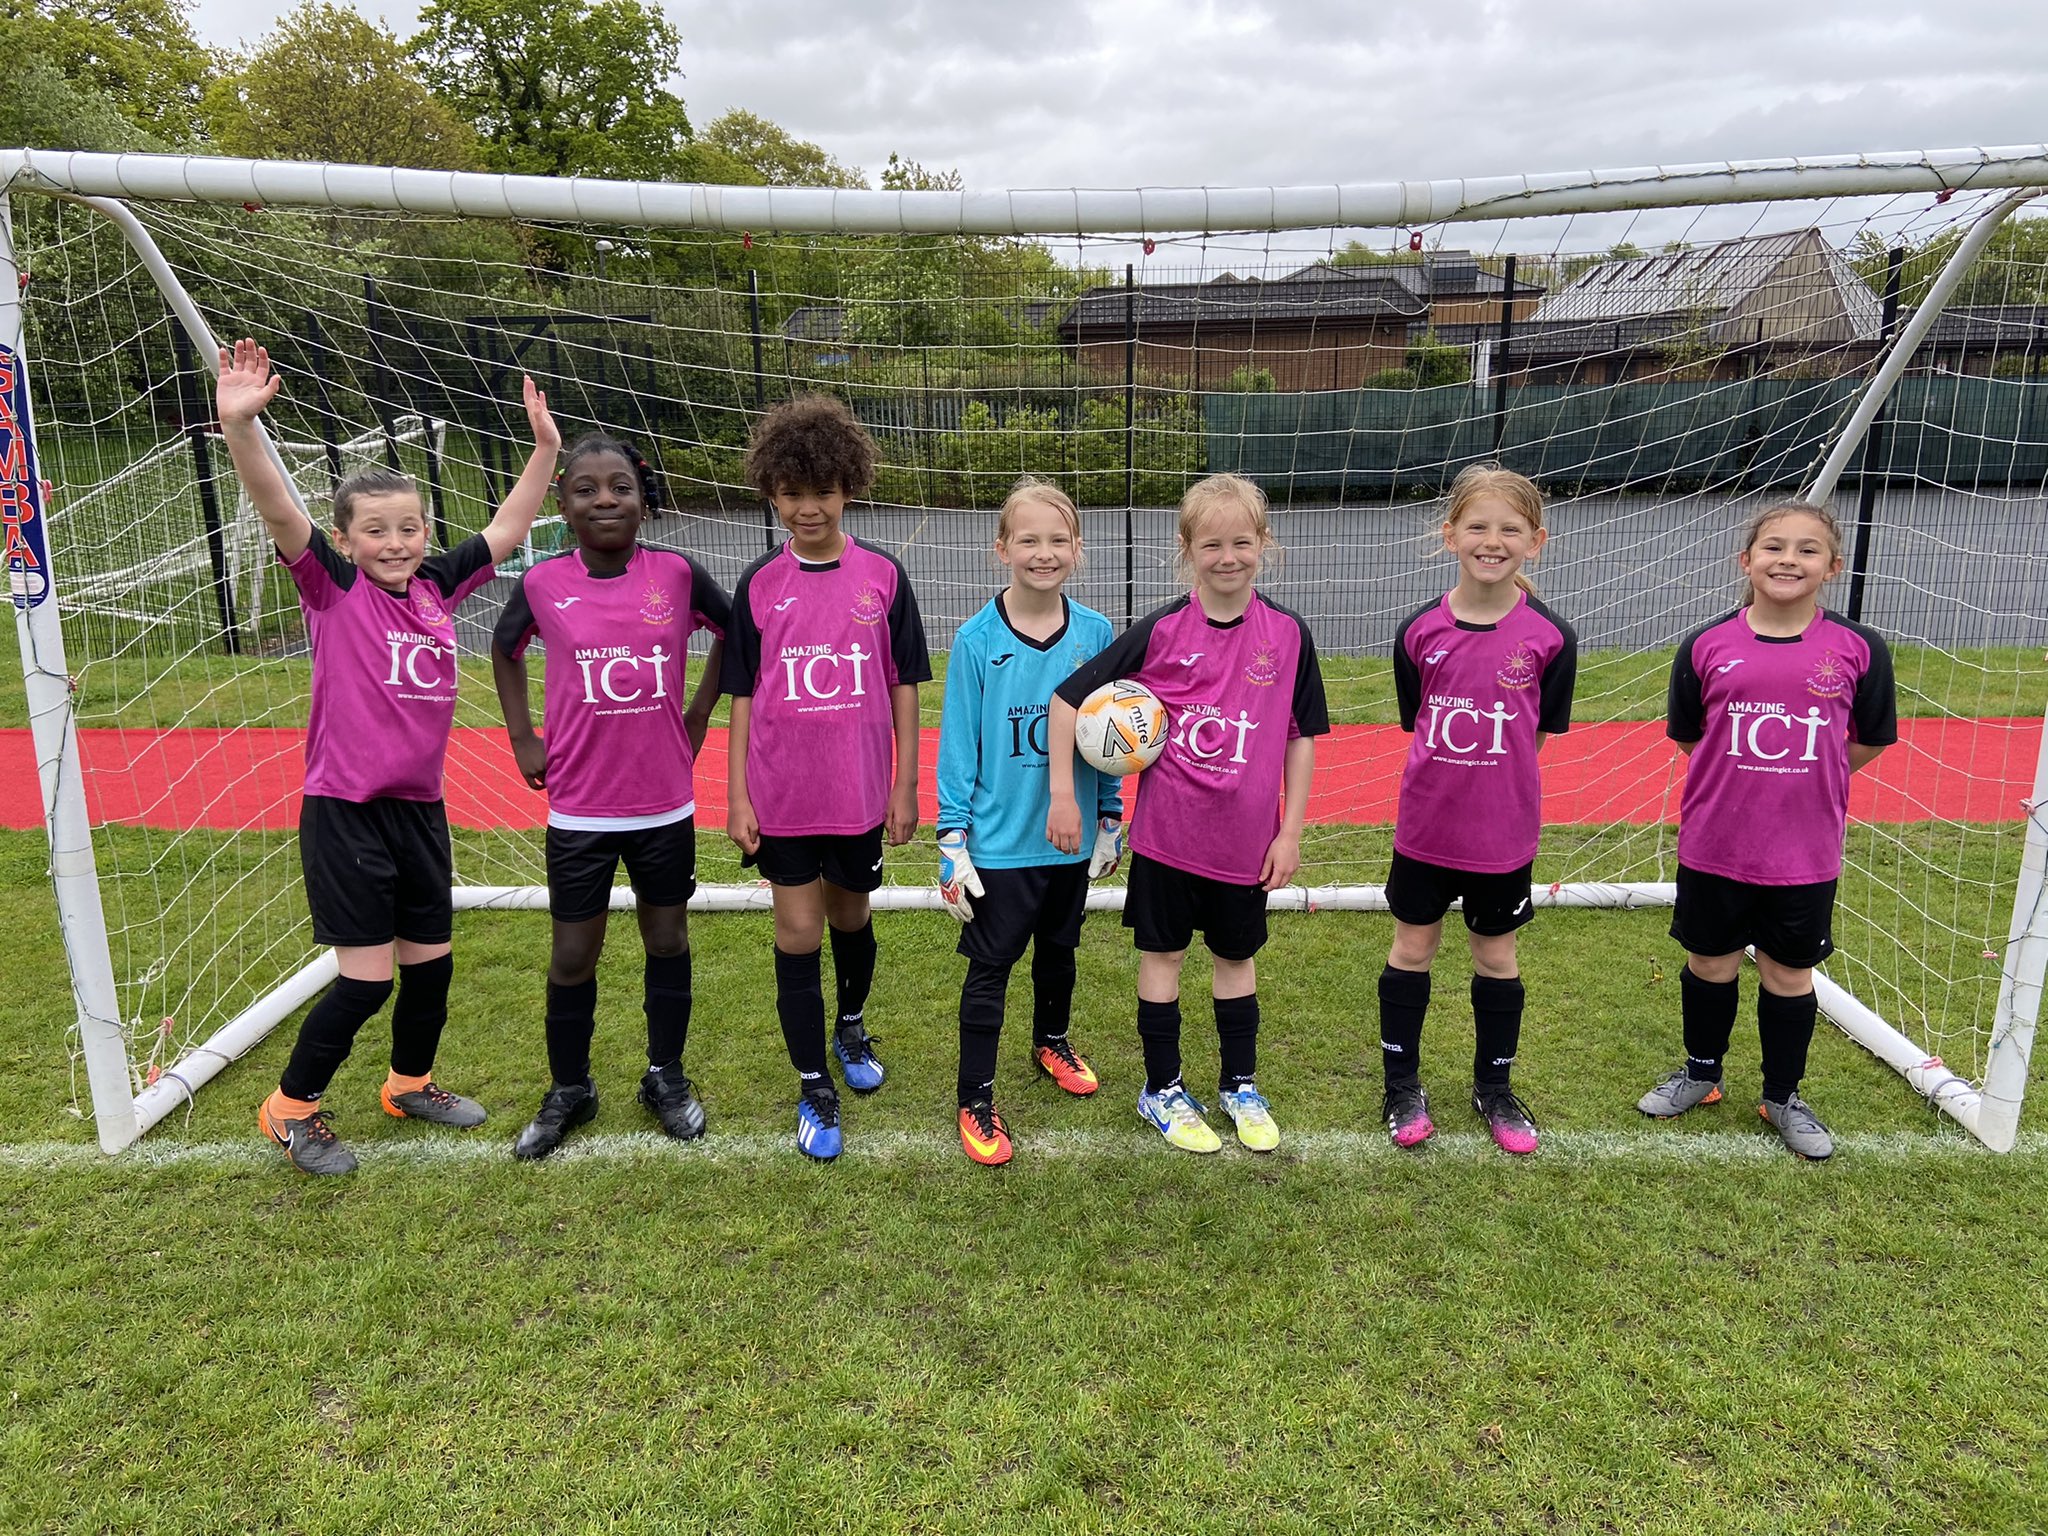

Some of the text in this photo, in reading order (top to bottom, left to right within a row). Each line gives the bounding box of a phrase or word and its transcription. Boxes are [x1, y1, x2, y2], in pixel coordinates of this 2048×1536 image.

[640, 608, 662, 621] Grange
[849, 608, 871, 621] Grange
[387, 630, 436, 645] AMAZING
[575, 646, 631, 660] AMAZING
[781, 644, 832, 658] AMAZING
[384, 638, 459, 690] ICT
[576, 645, 671, 704] ICT
[781, 643, 872, 701] ICT
[1497, 669, 1518, 685] Grange
[1806, 677, 1829, 692] Grange
[595, 703, 662, 717] www.amazingict.co.uk
[797, 702, 862, 713] www.amazingict.co.uk
[1007, 703, 1050, 717] AMAZIN
[1728, 701, 1786, 714] AMAZING
[1131, 706, 1149, 744] mitre
[1425, 700, 1519, 755] ICT
[1172, 709, 1260, 763] ICT
[1726, 706, 1831, 761] ICT
[1176, 753, 1239, 775] www.amazingict.co.uk
[1432, 755, 1498, 767] www.amazingict.co.uk
[1737, 763, 1810, 774] www.amazingict.co.uk
[799, 1071, 822, 1080] oma
